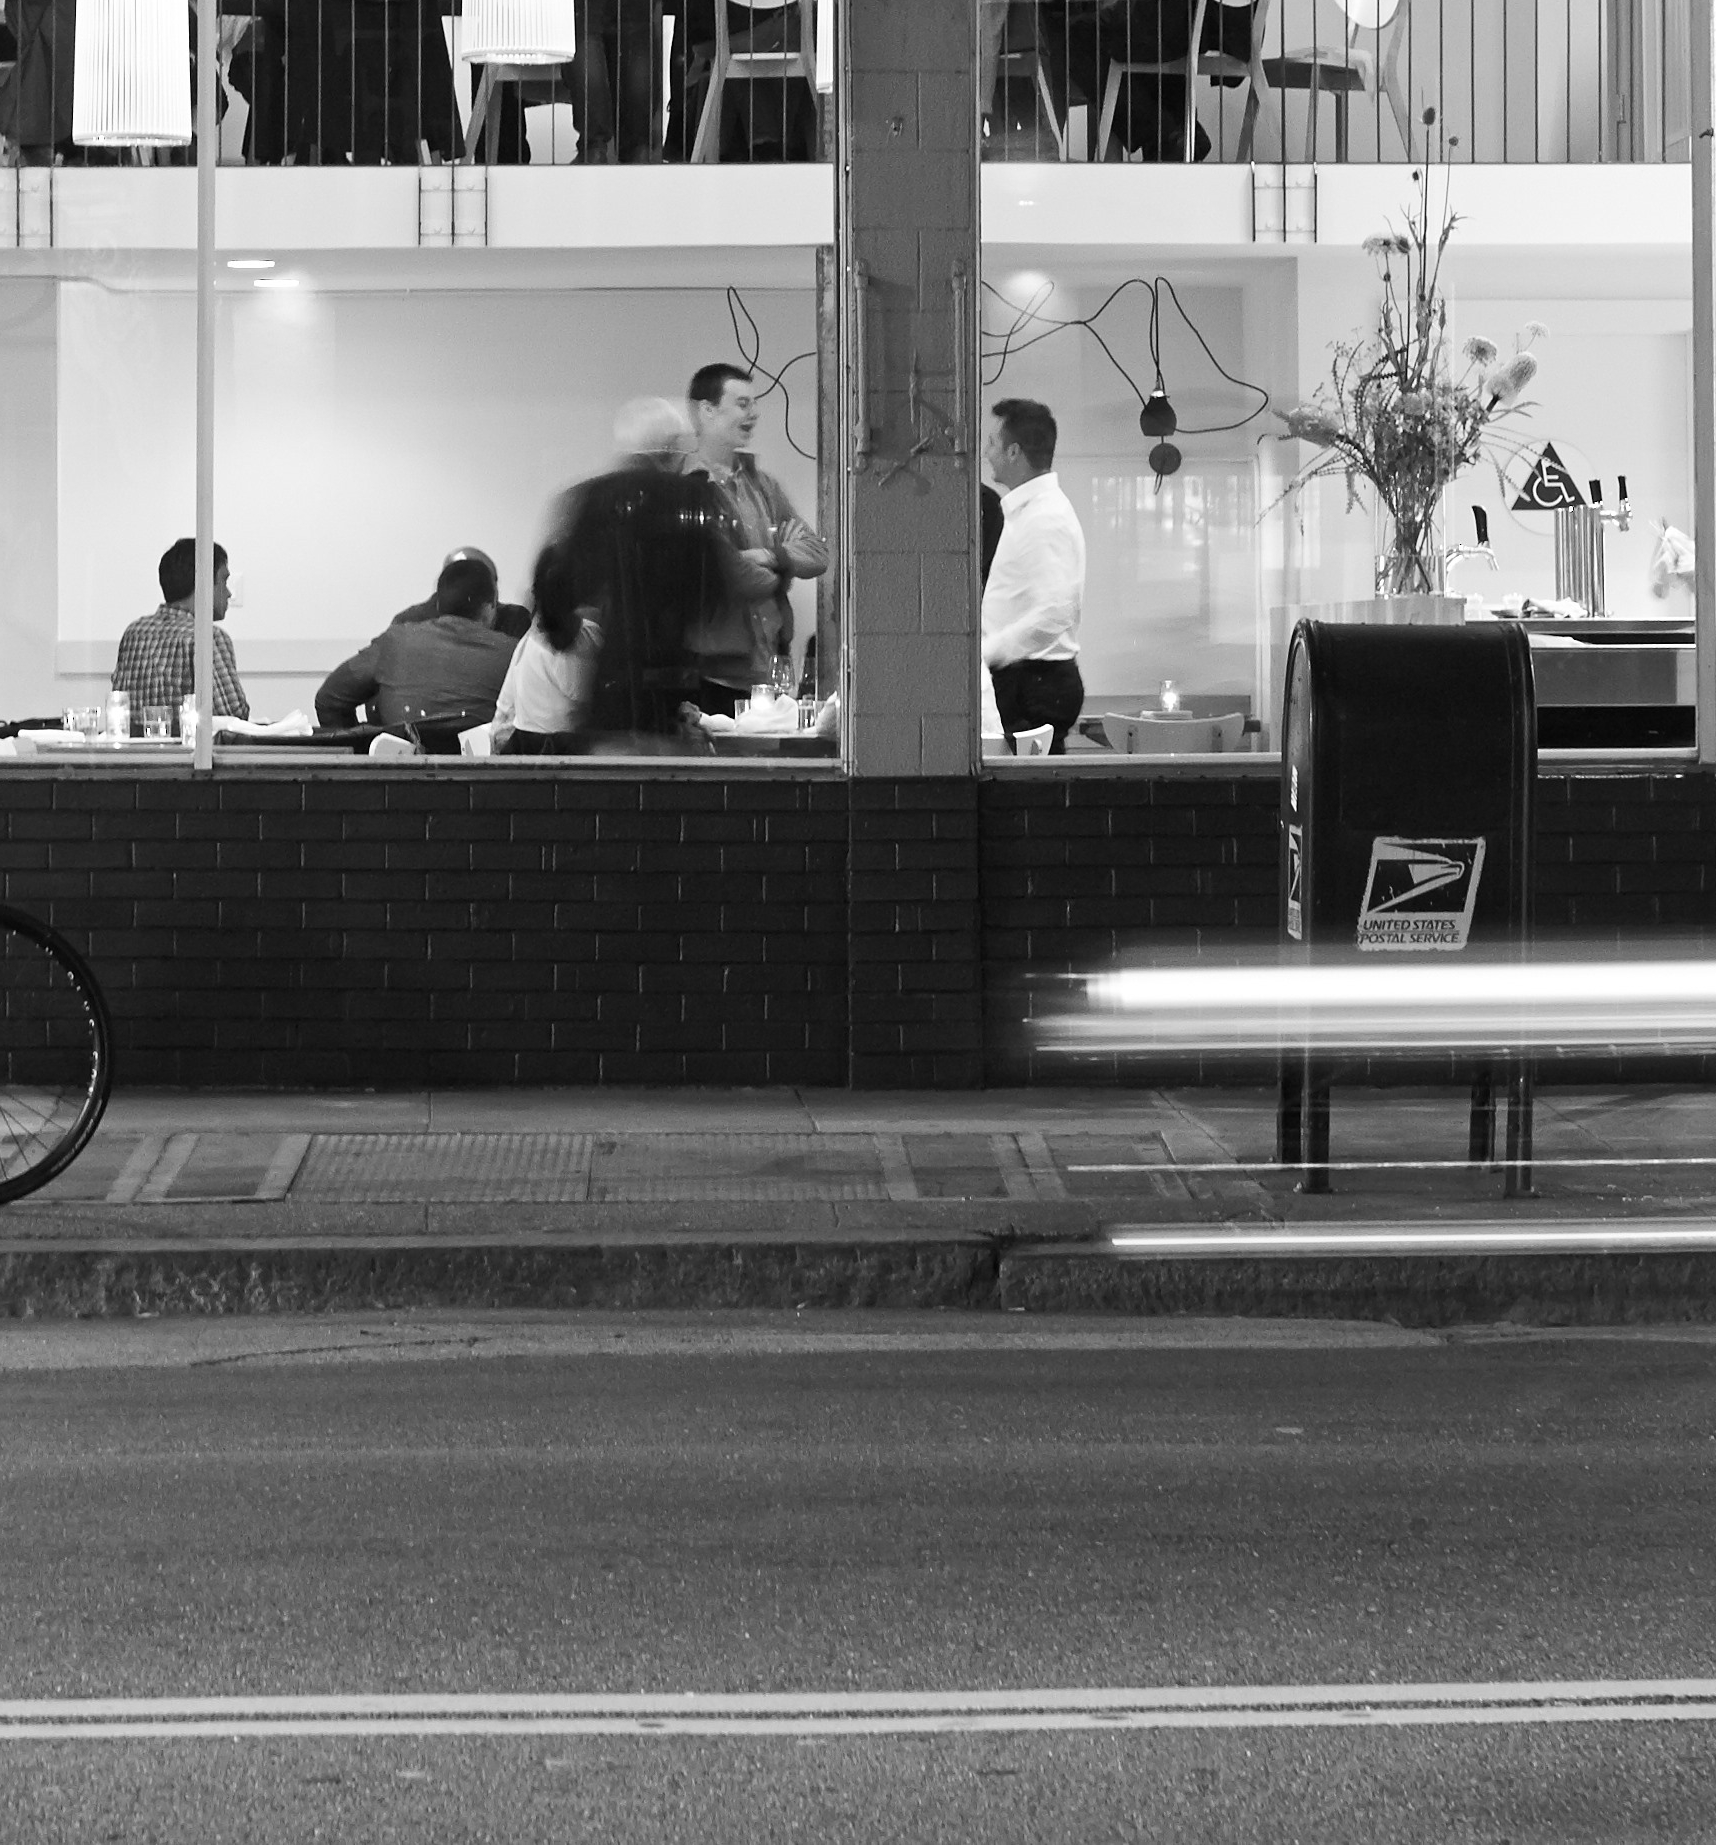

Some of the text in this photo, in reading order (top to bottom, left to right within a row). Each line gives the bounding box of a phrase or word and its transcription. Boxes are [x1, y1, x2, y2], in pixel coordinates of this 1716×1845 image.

[1363, 919, 1457, 931] UNITED STATES
[1360, 934, 1459, 944] POSTAL SERVICE
